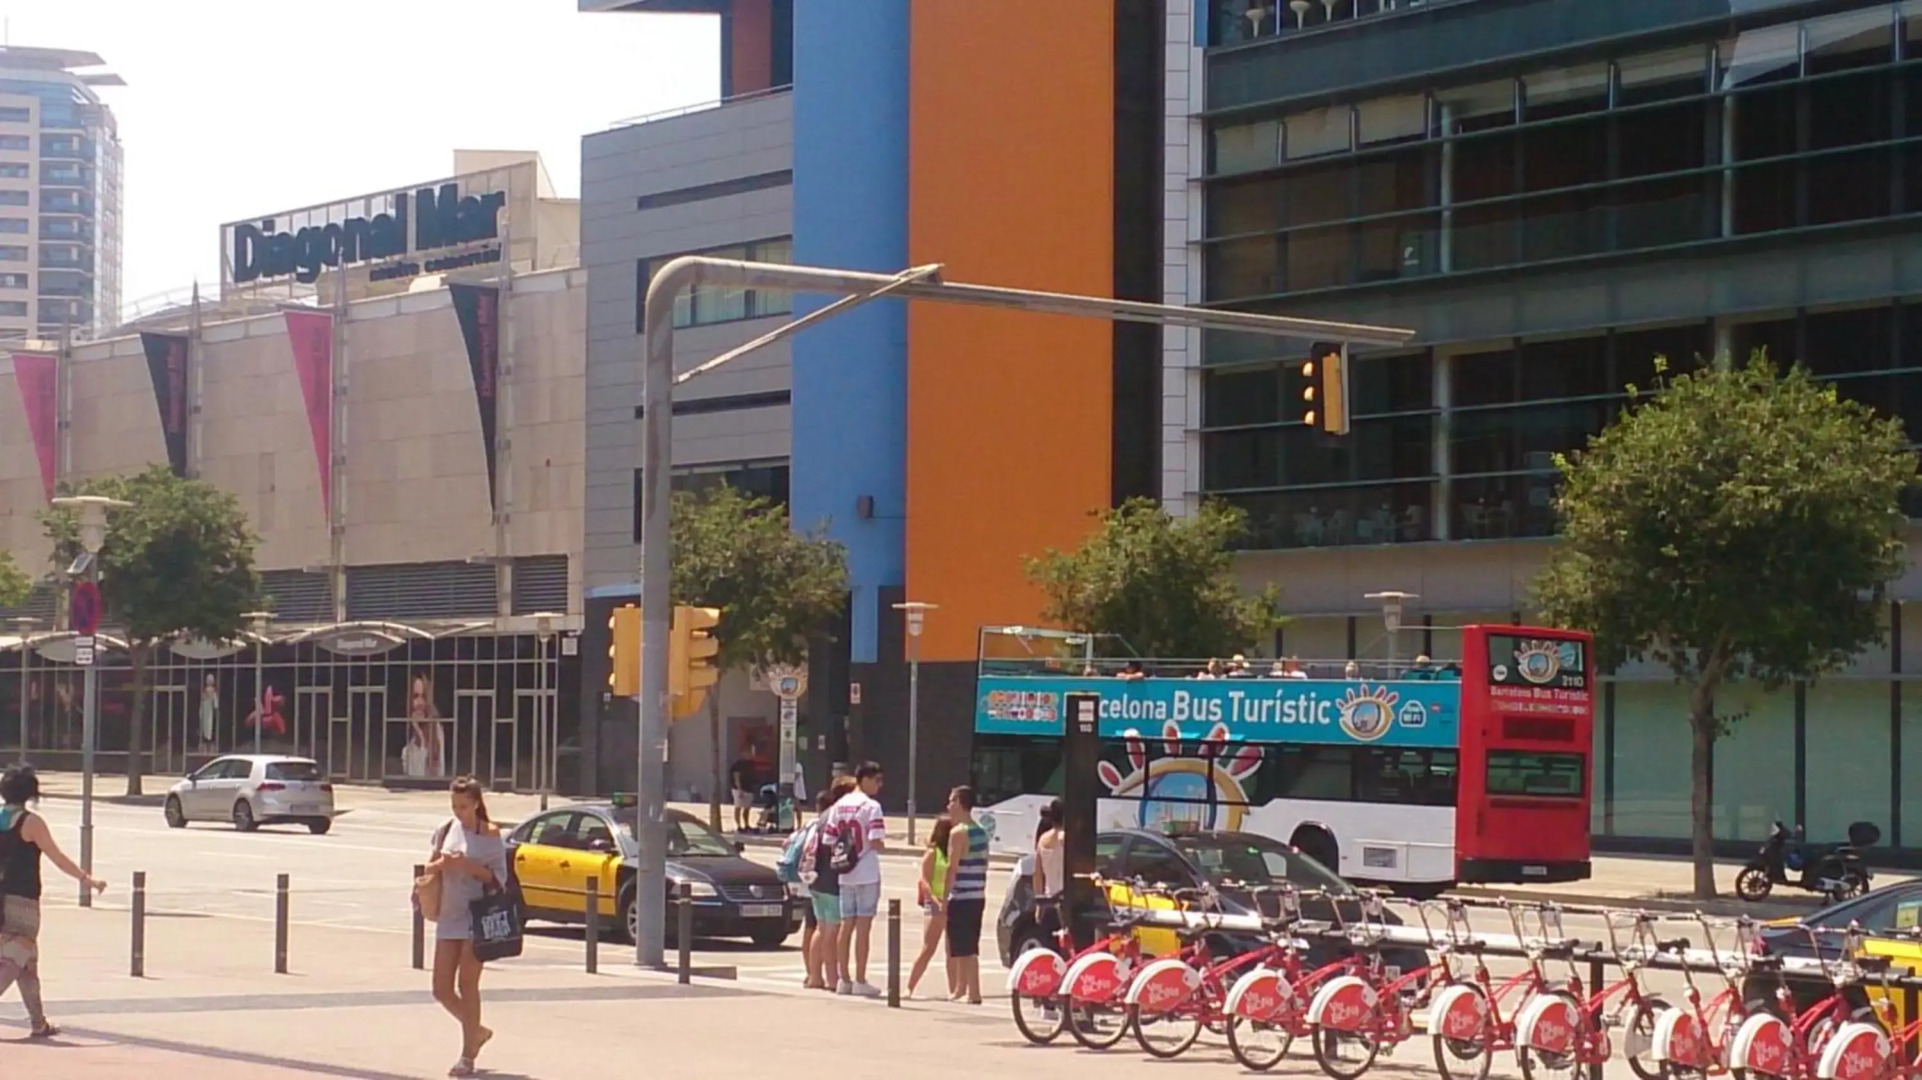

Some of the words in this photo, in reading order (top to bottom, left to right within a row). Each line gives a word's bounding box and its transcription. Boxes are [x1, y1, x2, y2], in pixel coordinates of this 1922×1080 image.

[234, 192, 408, 283] Diagonal
[415, 183, 505, 251] Mar
[1173, 690, 1222, 722] Bus
[1228, 688, 1332, 725] Turístic
[1533, 687, 1552, 699] Bus
